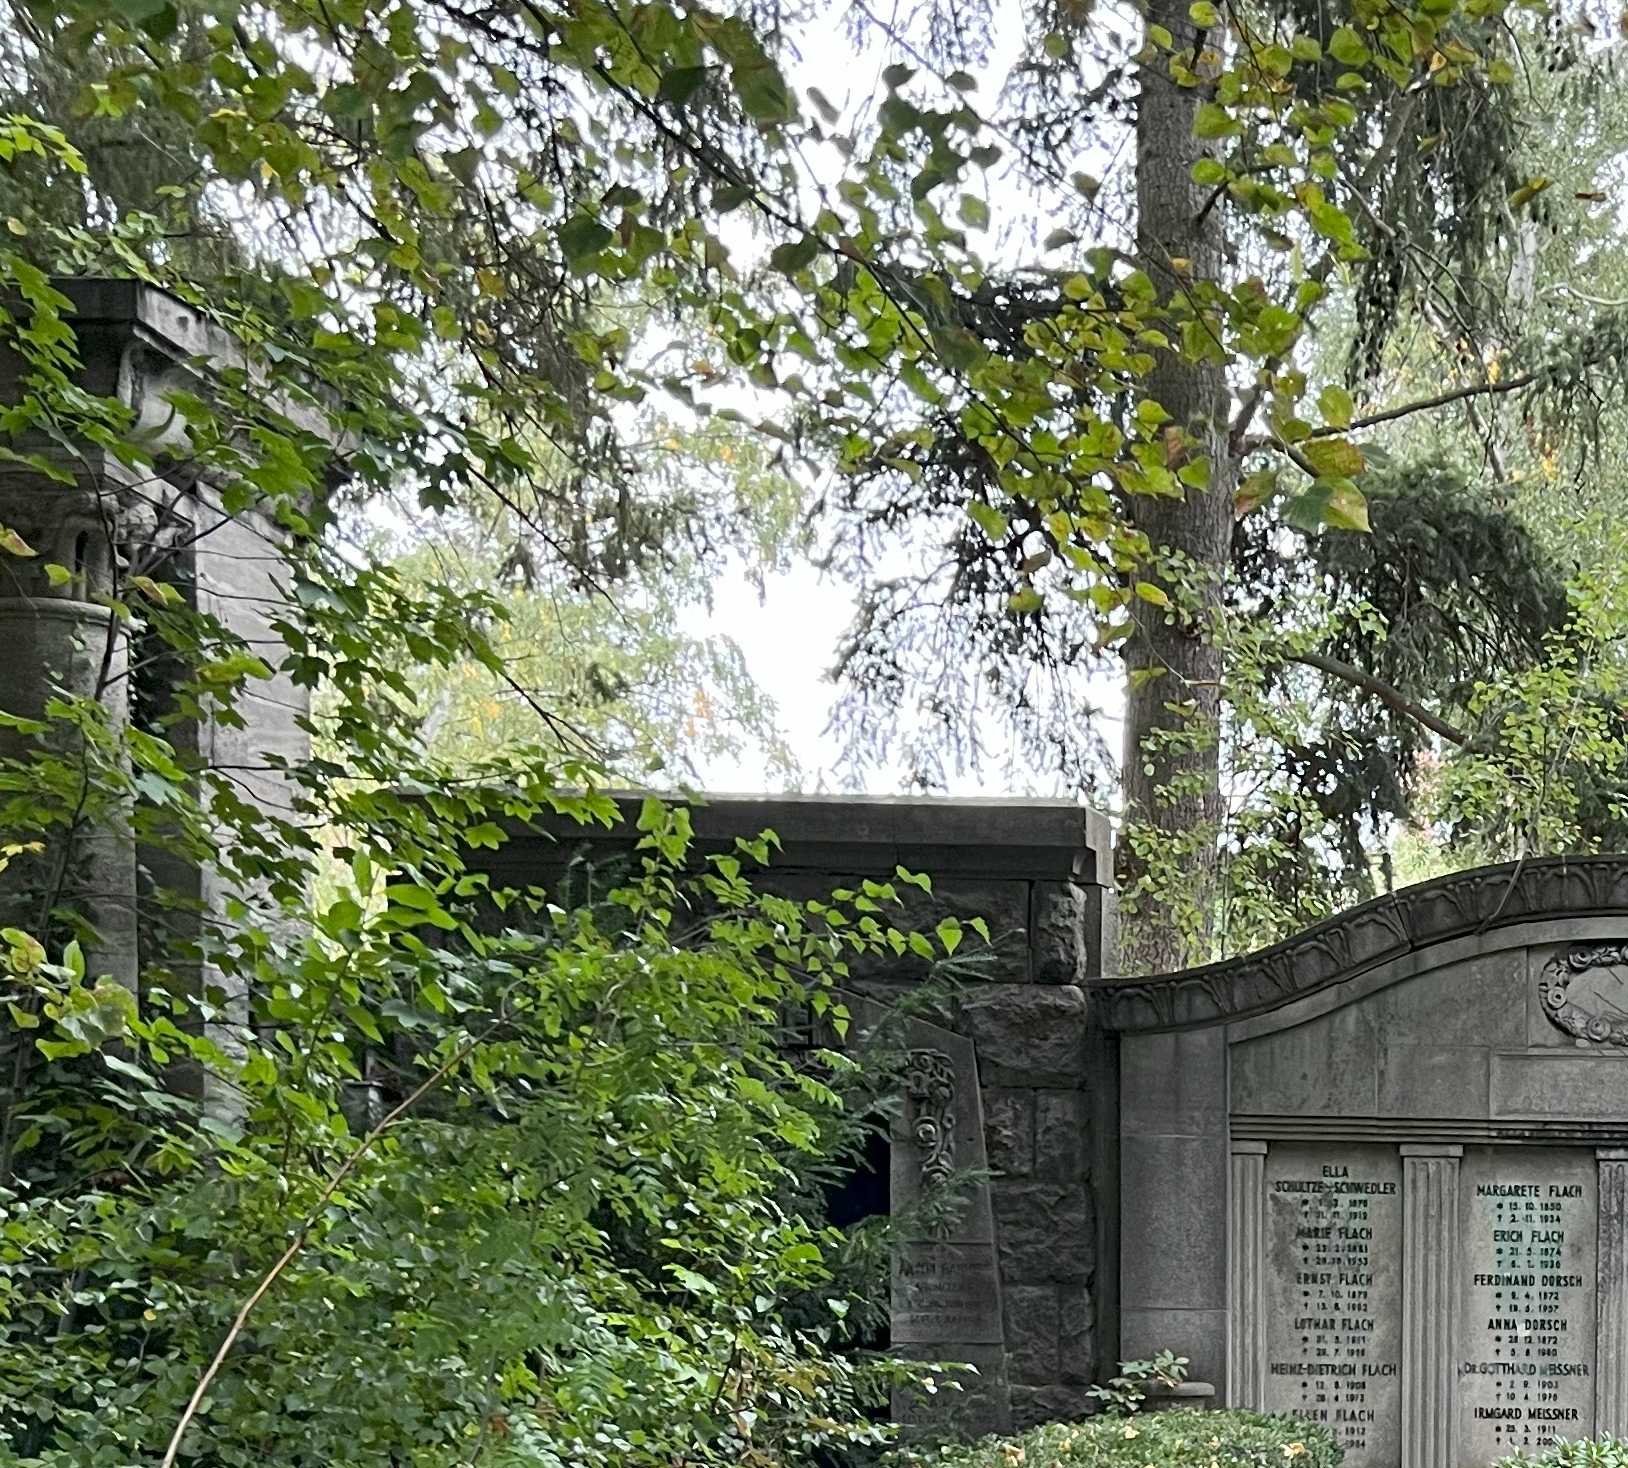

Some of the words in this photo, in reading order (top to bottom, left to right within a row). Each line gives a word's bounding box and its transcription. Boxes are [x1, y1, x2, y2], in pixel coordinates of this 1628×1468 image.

[1322, 1165, 1349, 1178] ELLA
[1476, 1184, 1541, 1198] MARGARETE
[1549, 1185, 1583, 1198] FLACH
[1296, 1226, 1332, 1239] MARIE
[1338, 1227, 1373, 1240] FLACH
[1493, 1230, 1523, 1243] ERICH
[1531, 1230, 1565, 1243] FLACH
[1296, 1272, 1332, 1285] ERNST
[1339, 1273, 1373, 1285] FLACH
[1473, 1273, 1536, 1287] FERDINAND
[1541, 1275, 1583, 1288] DORSCH
[1294, 1317, 1336, 1331] LOTHAR
[1341, 1318, 1375, 1331] FLACH
[1487, 1318, 1518, 1331] ANNA
[1524, 1318, 1568, 1332] DORSCH
[1270, 1363, 1357, 1377] HEINZ-DIETRICH
[1362, 1363, 1397, 1377] FLACH
[1539, 1363, 1590, 1378] MEISSNER
[1335, 1409, 1375, 1422] FLACH
[1474, 1407, 1522, 1420] IRMGARD
[1528, 1407, 1580, 1421] MEISSNER
